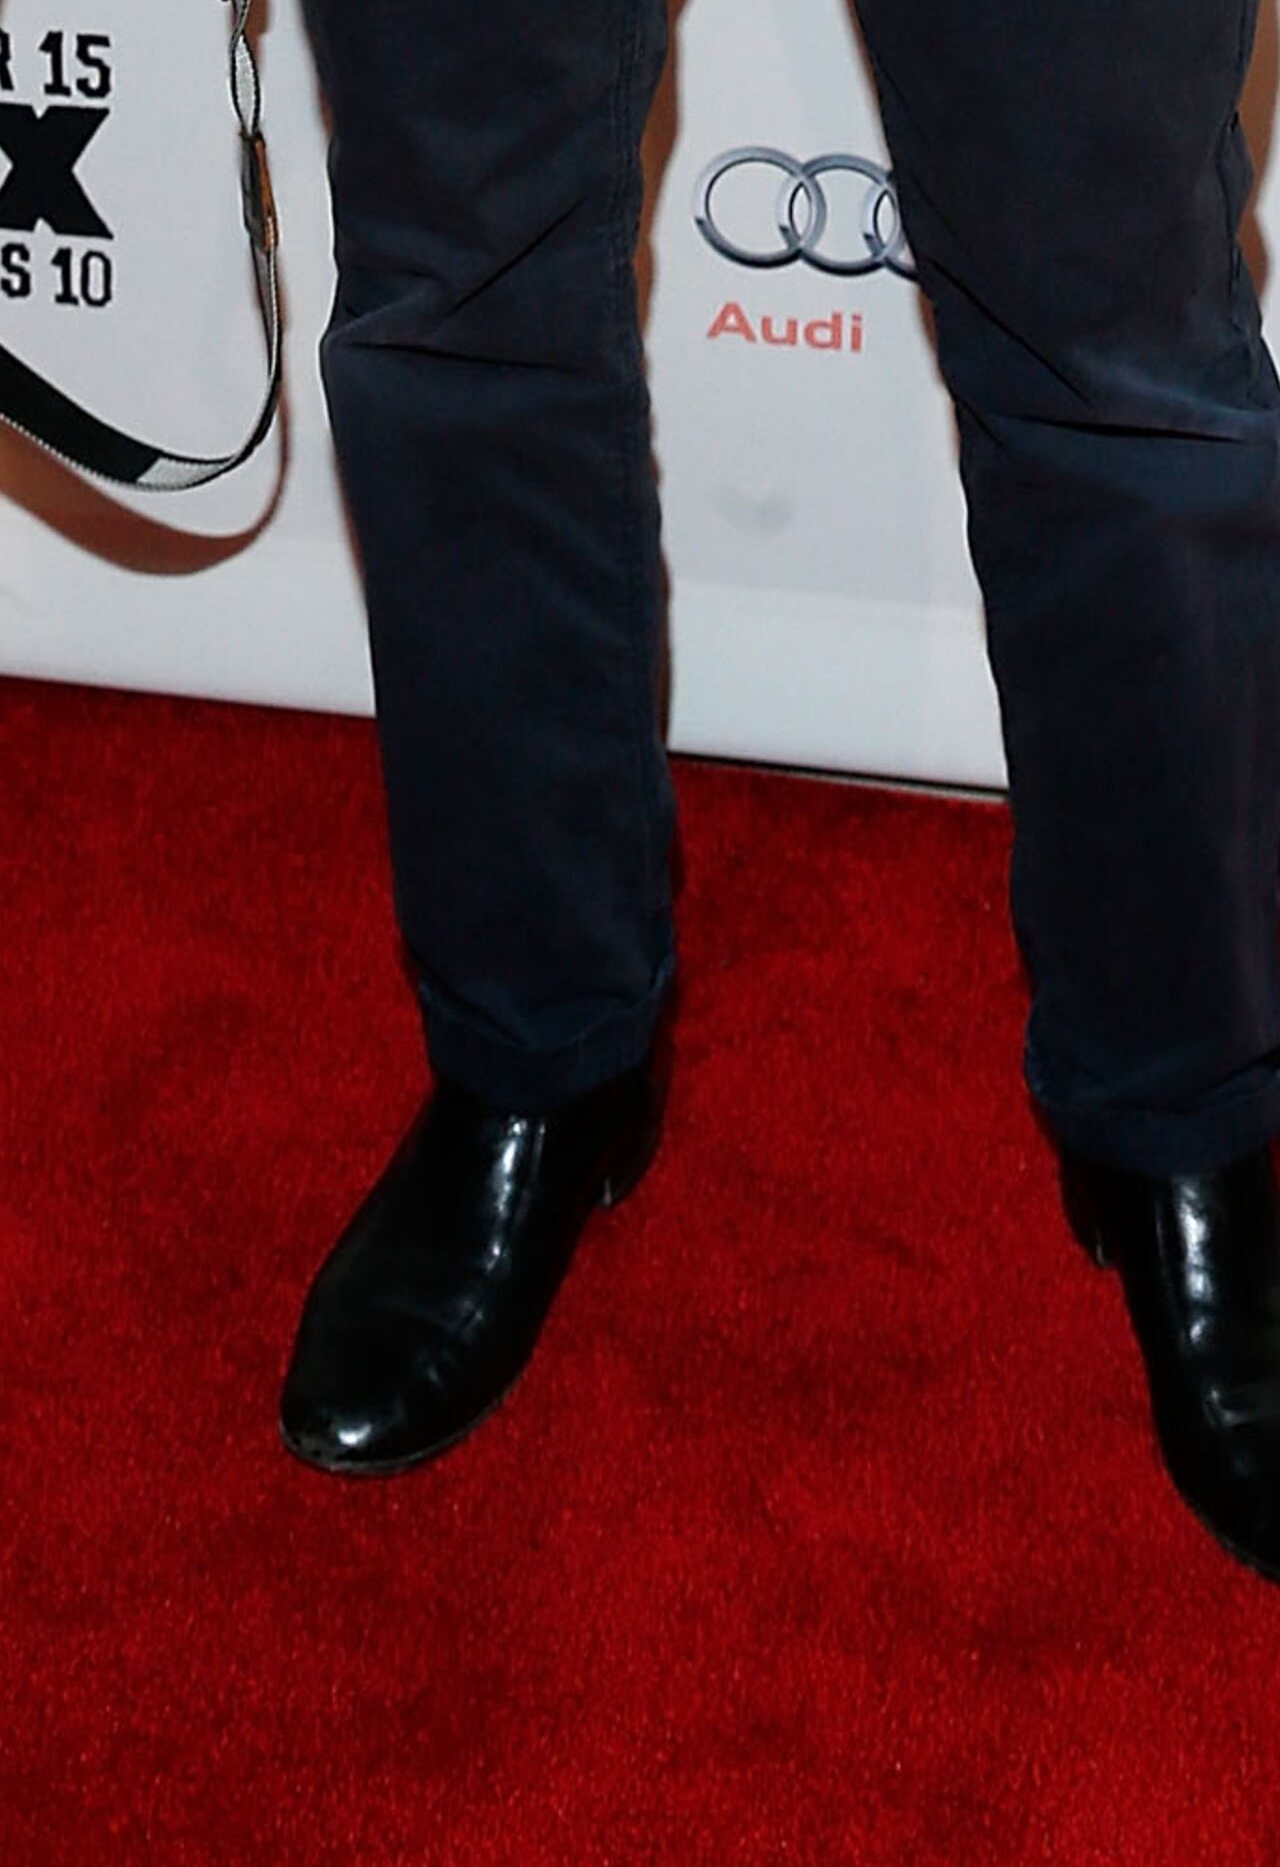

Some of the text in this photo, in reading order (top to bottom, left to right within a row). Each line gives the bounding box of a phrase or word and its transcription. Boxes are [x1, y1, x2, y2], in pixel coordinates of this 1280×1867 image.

[39, 31, 113, 98] 15
[51, 246, 114, 308] 10
[706, 300, 866, 354] Audi
